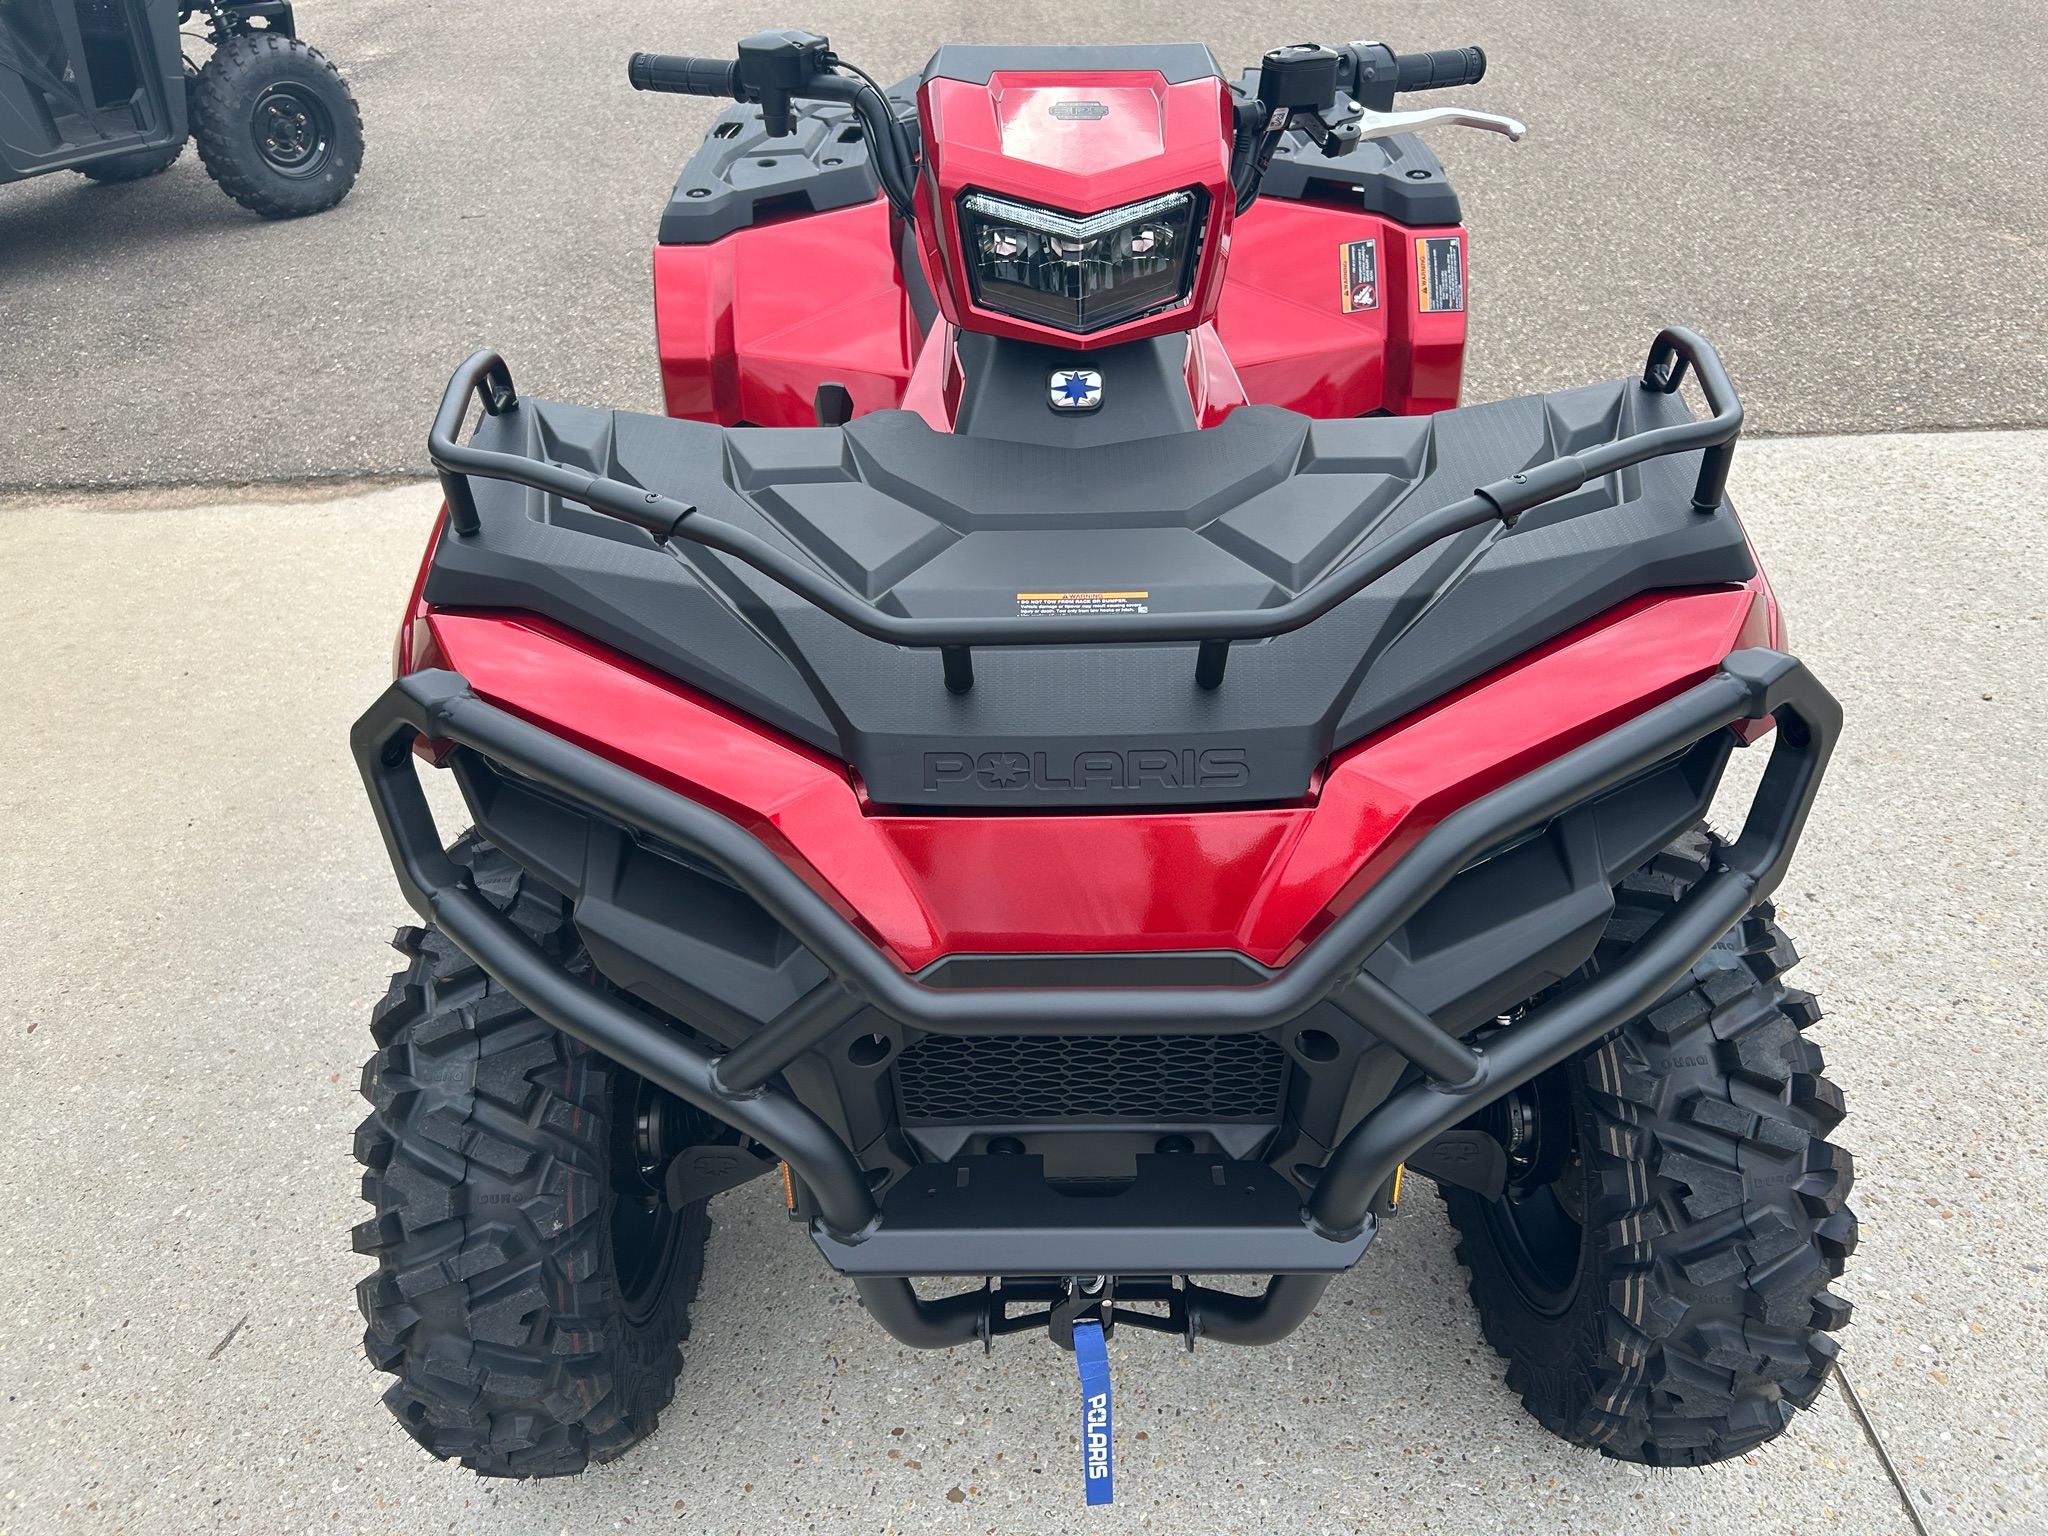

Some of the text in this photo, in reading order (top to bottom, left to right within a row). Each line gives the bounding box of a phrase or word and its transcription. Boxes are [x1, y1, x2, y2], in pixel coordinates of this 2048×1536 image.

[924, 749, 1250, 791] POLARIS
[1661, 1055, 1709, 1069] DURO
[1754, 1173, 1794, 1188] DURO
[479, 1193, 523, 1205] DURO
[1686, 1291, 1733, 1304] DURO
[1088, 1393, 1108, 1479] POLARIS
